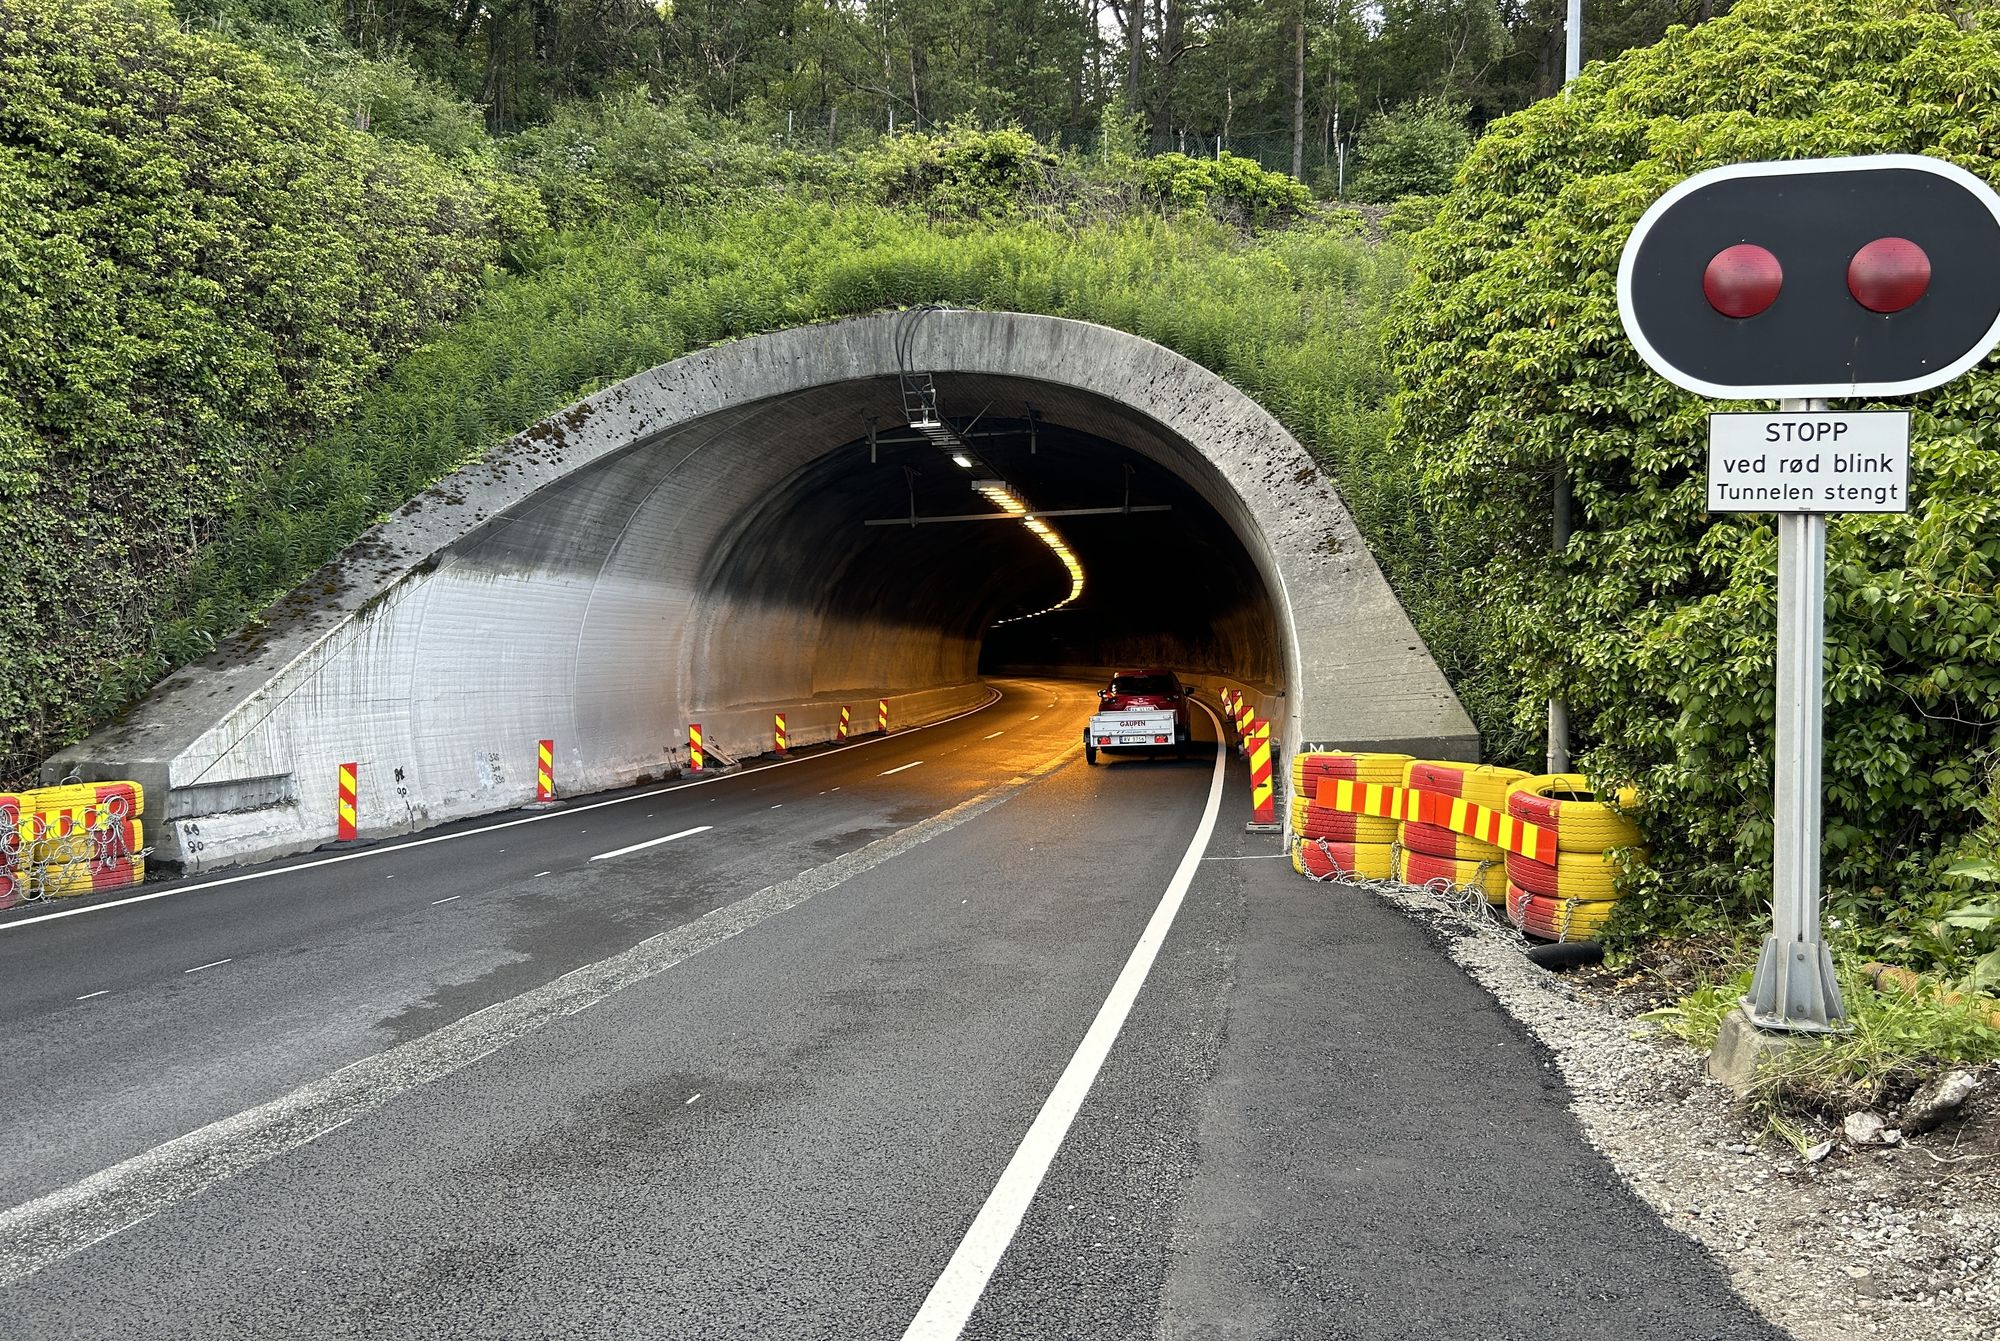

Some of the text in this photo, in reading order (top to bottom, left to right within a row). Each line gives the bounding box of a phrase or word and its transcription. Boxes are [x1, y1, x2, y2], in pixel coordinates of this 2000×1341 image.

[1765, 421, 1849, 442] STOPP
[1723, 453, 1894, 473] ved rød blink
[1717, 483, 1898, 504] Tunnelen stengt
